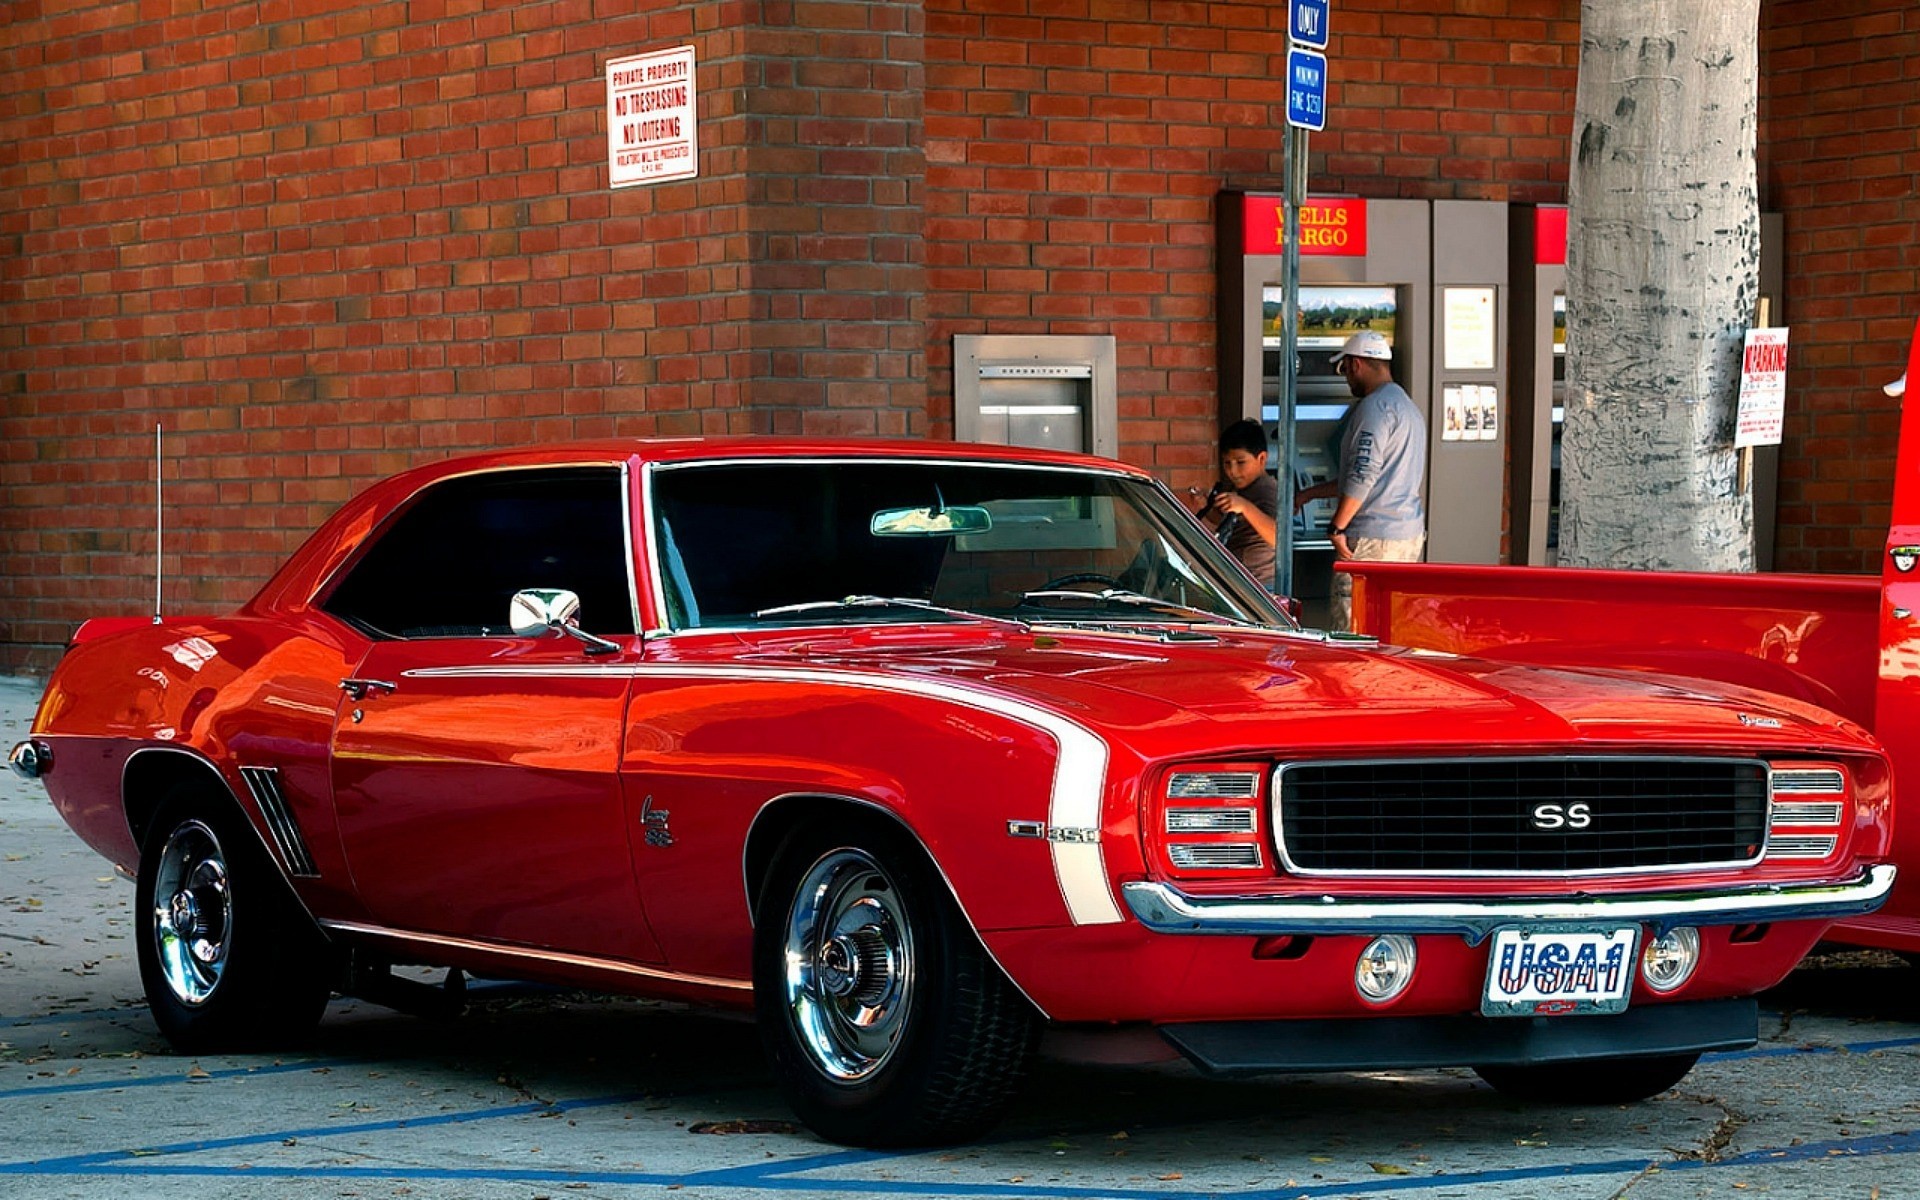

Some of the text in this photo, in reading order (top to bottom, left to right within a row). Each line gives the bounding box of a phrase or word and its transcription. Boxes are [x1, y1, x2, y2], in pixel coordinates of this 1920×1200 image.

[1298, 3, 1320, 36] ONLY
[613, 61, 688, 87] PRIVATE PROPERTY
[616, 85, 688, 117] NO TRESPASSING
[1291, 89, 1305, 111] FINE
[623, 116, 680, 144] NO LOITERING
[1534, 804, 1591, 829] SS
